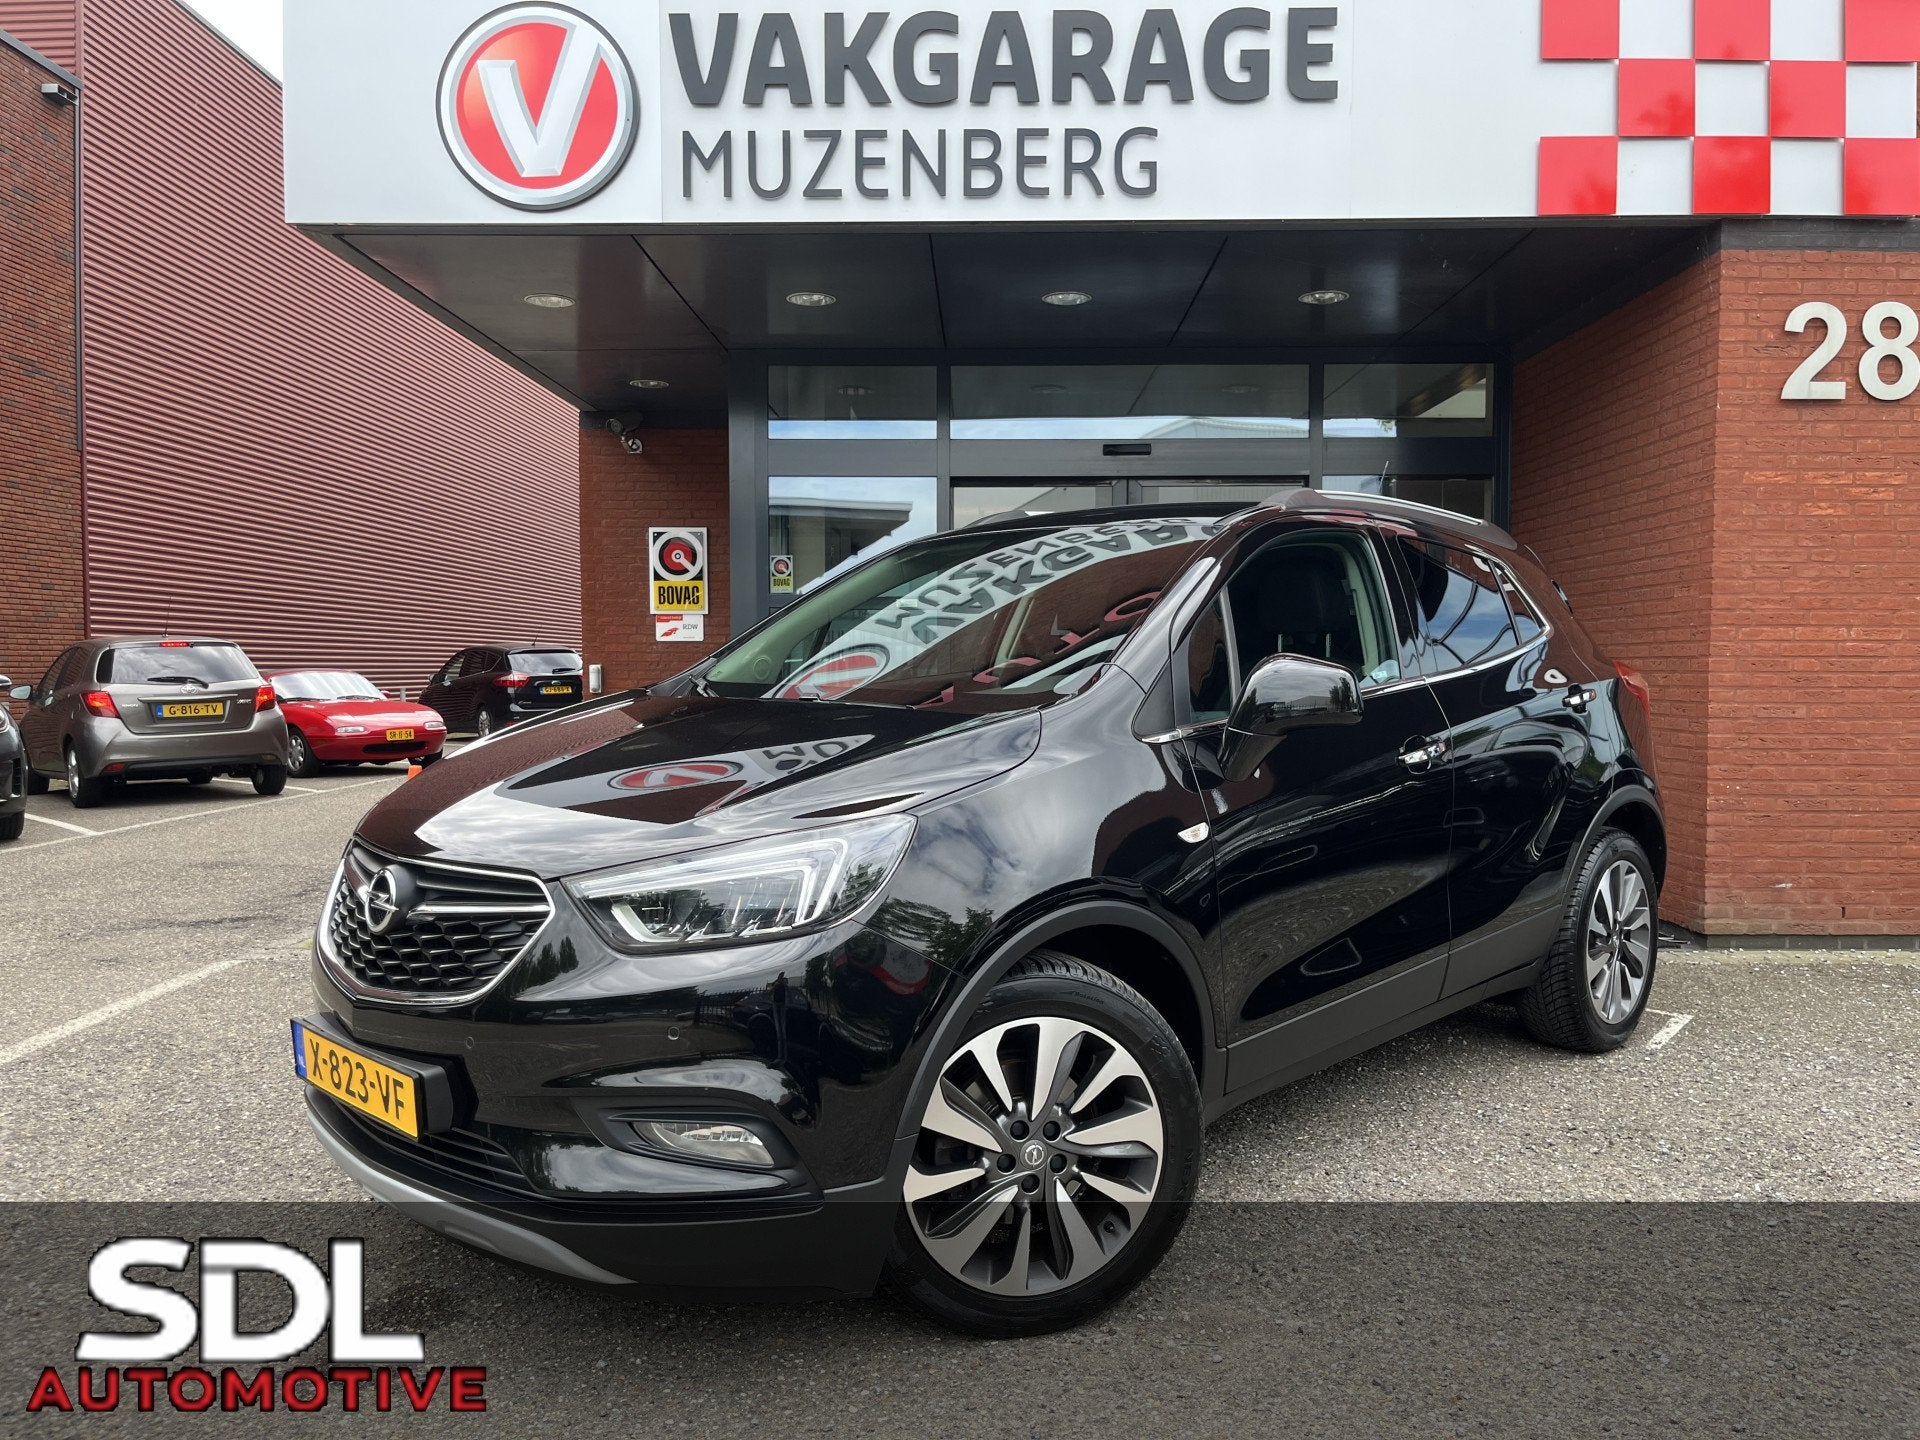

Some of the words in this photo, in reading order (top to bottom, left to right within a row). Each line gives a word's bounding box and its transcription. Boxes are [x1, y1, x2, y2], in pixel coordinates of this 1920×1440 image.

[668, 7, 1338, 105] VAKGARAGE
[682, 126, 1158, 199] MUZENBERG
[1780, 301, 1920, 401] 28
[658, 585, 700, 605] BOVAG
[773, 578, 791, 587] BOVAG
[169, 704, 218, 716] G-816-TV
[309, 1038, 405, 1120] X-823-VF
